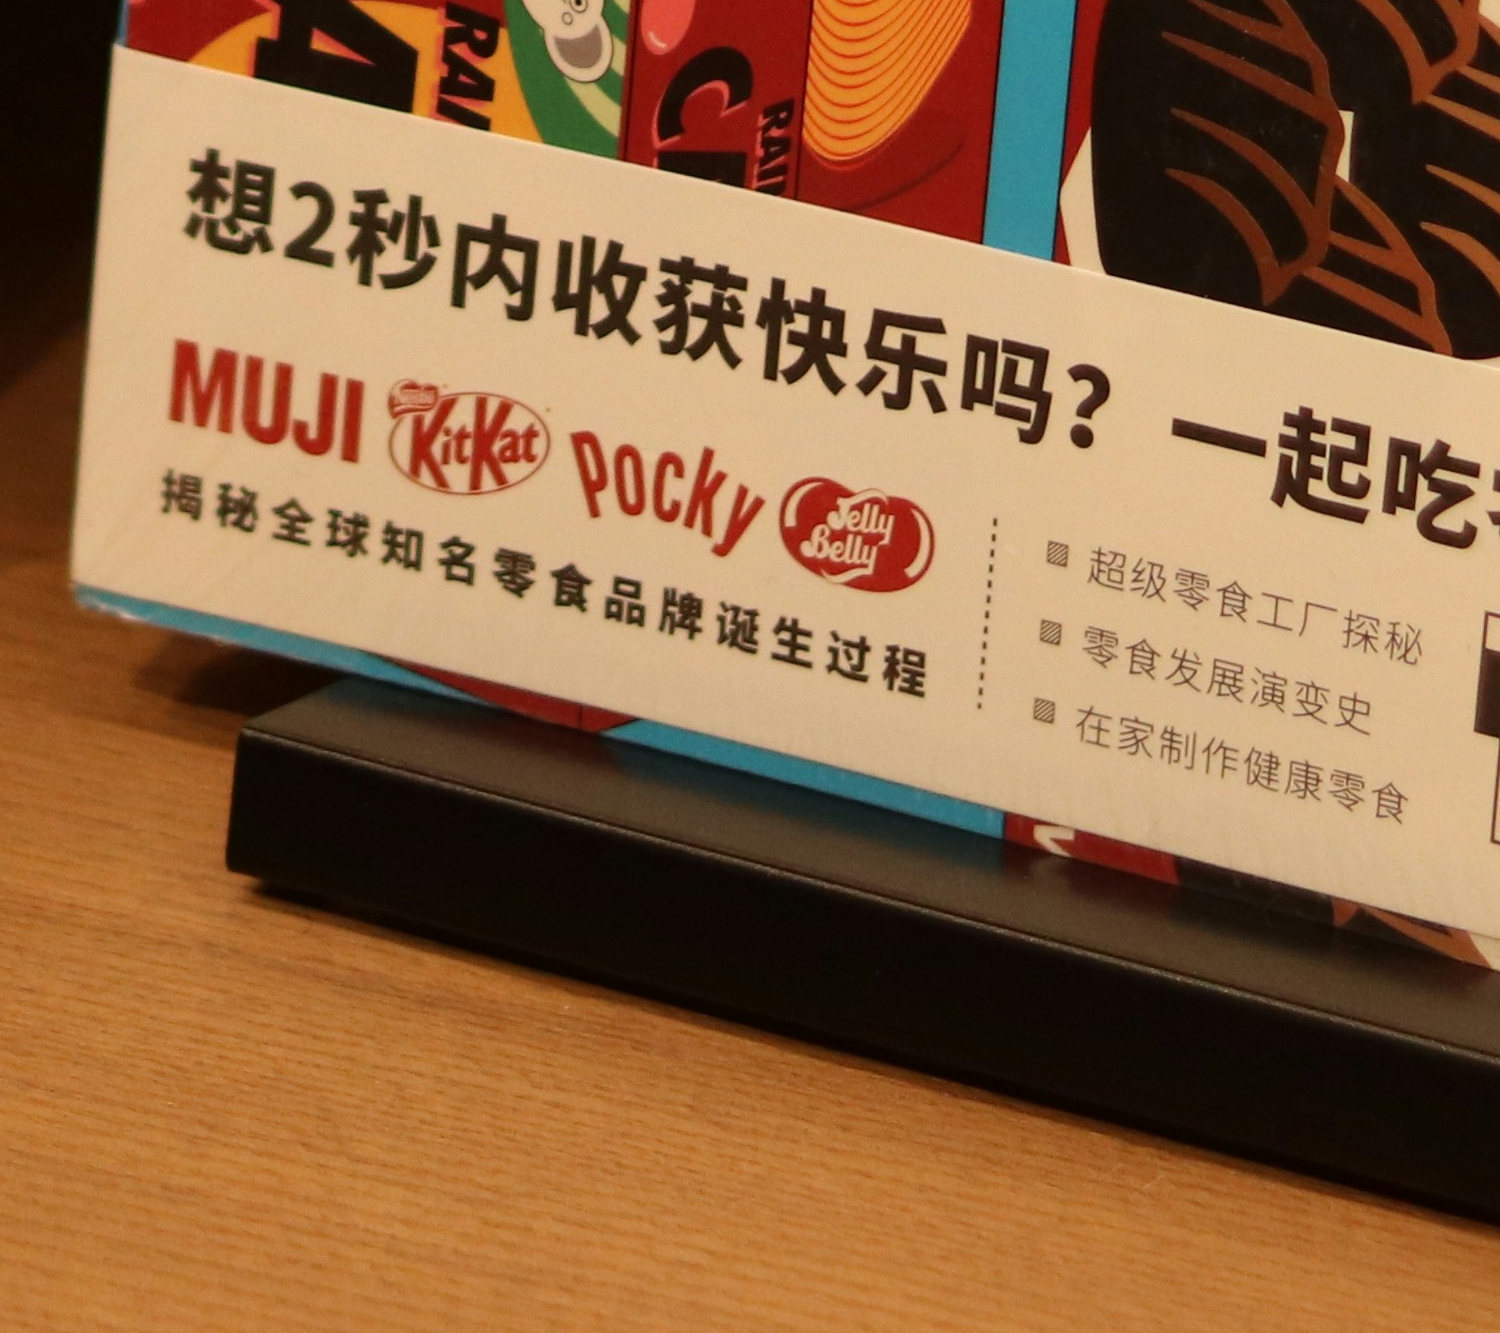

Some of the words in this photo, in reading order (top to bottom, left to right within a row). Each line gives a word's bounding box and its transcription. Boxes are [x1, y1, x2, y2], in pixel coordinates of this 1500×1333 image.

[168, 339, 365, 464] MUJI
[409, 395, 540, 492] KitKat
[804, 524, 878, 571] Belly
[826, 493, 896, 546] Jelly
[159, 470, 929, 699] 揭秘全球知名零食品牌诞生过程
[1087, 544, 1424, 668] 超级零食工厂探秘
[1082, 624, 1372, 737] 零食发展演变史
[1075, 703, 1411, 827] 在家制作健康零食
